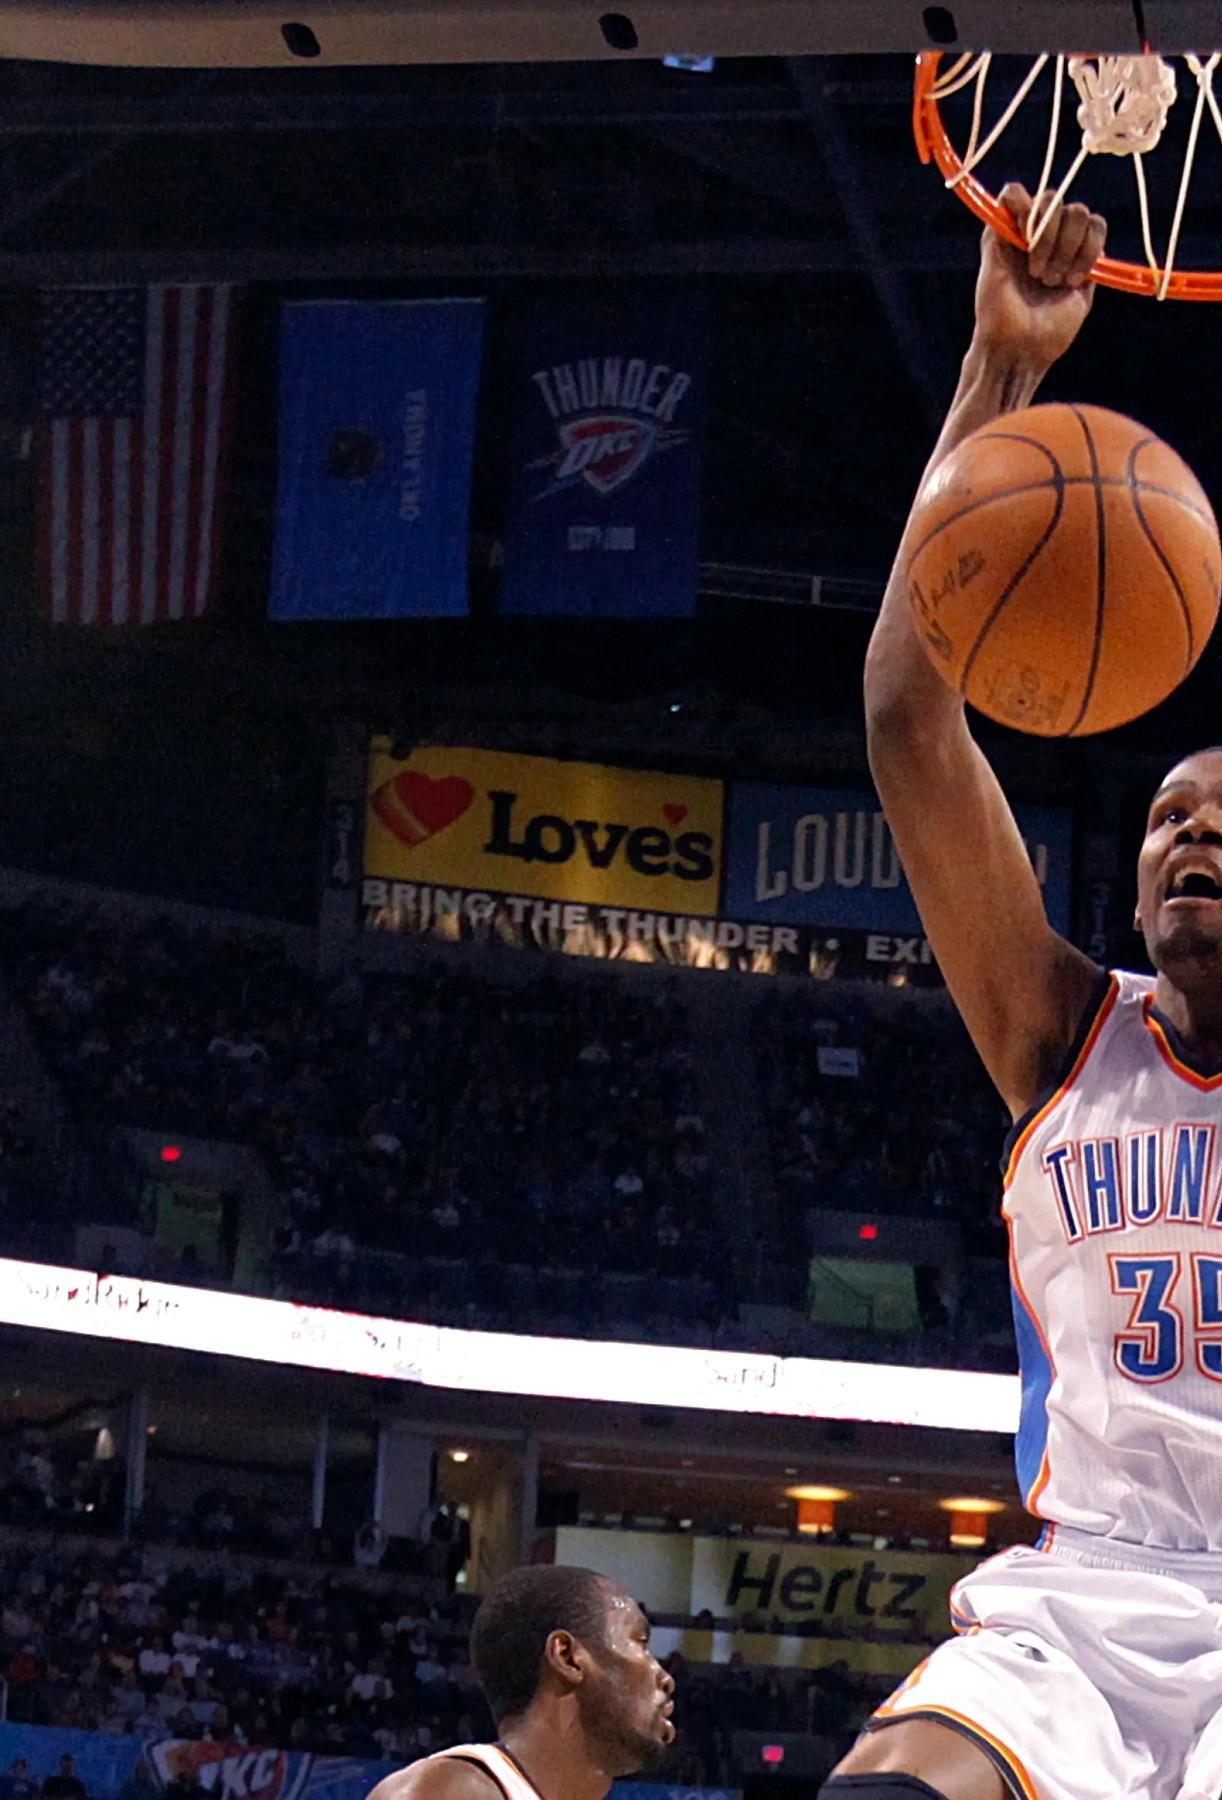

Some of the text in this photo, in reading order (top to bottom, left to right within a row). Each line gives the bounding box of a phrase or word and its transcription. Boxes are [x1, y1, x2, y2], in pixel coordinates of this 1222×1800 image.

[530, 356, 692, 423] THUNDER
[362, 879, 498, 918] BRING
[505, 896, 589, 930] THE
[602, 909, 799, 954] THUNDER
[726, 1551, 926, 1618] Hertz
